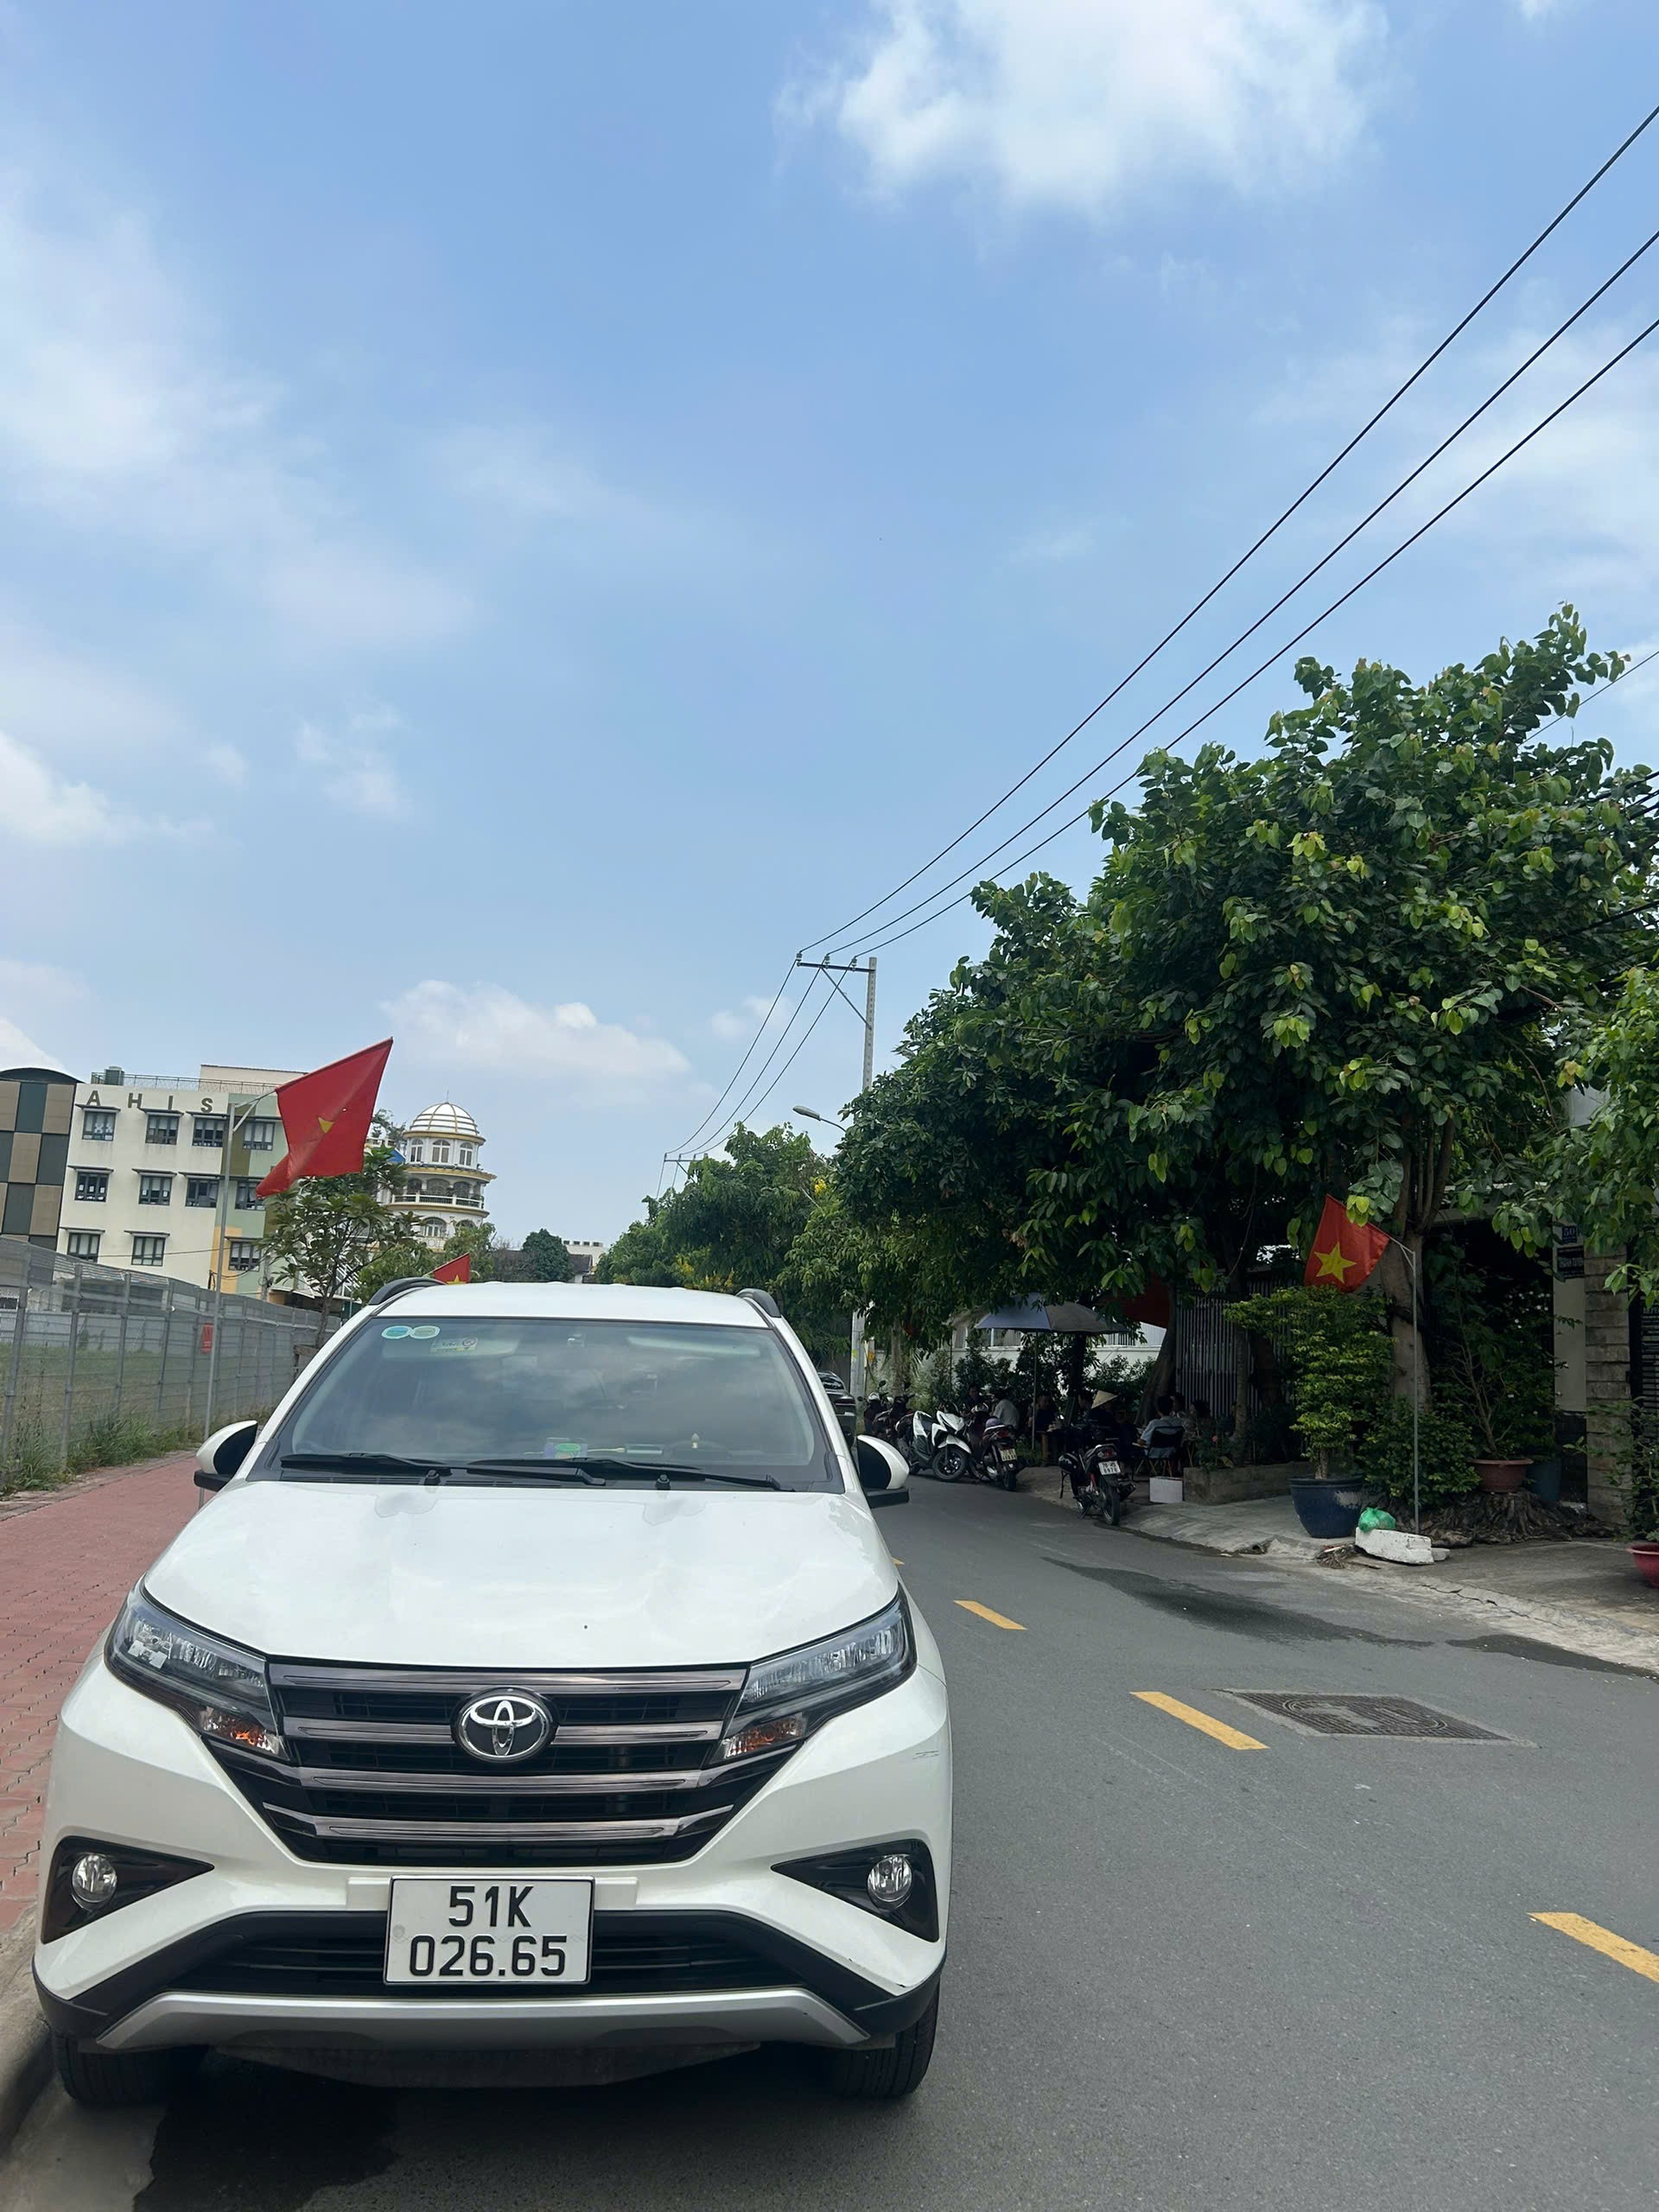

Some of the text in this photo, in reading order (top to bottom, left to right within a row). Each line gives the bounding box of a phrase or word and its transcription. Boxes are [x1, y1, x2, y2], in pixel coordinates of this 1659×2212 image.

[86, 1090, 213, 1113] AHIS
[448, 1886, 534, 1927] 51K
[410, 1936, 567, 1976] 026.65
